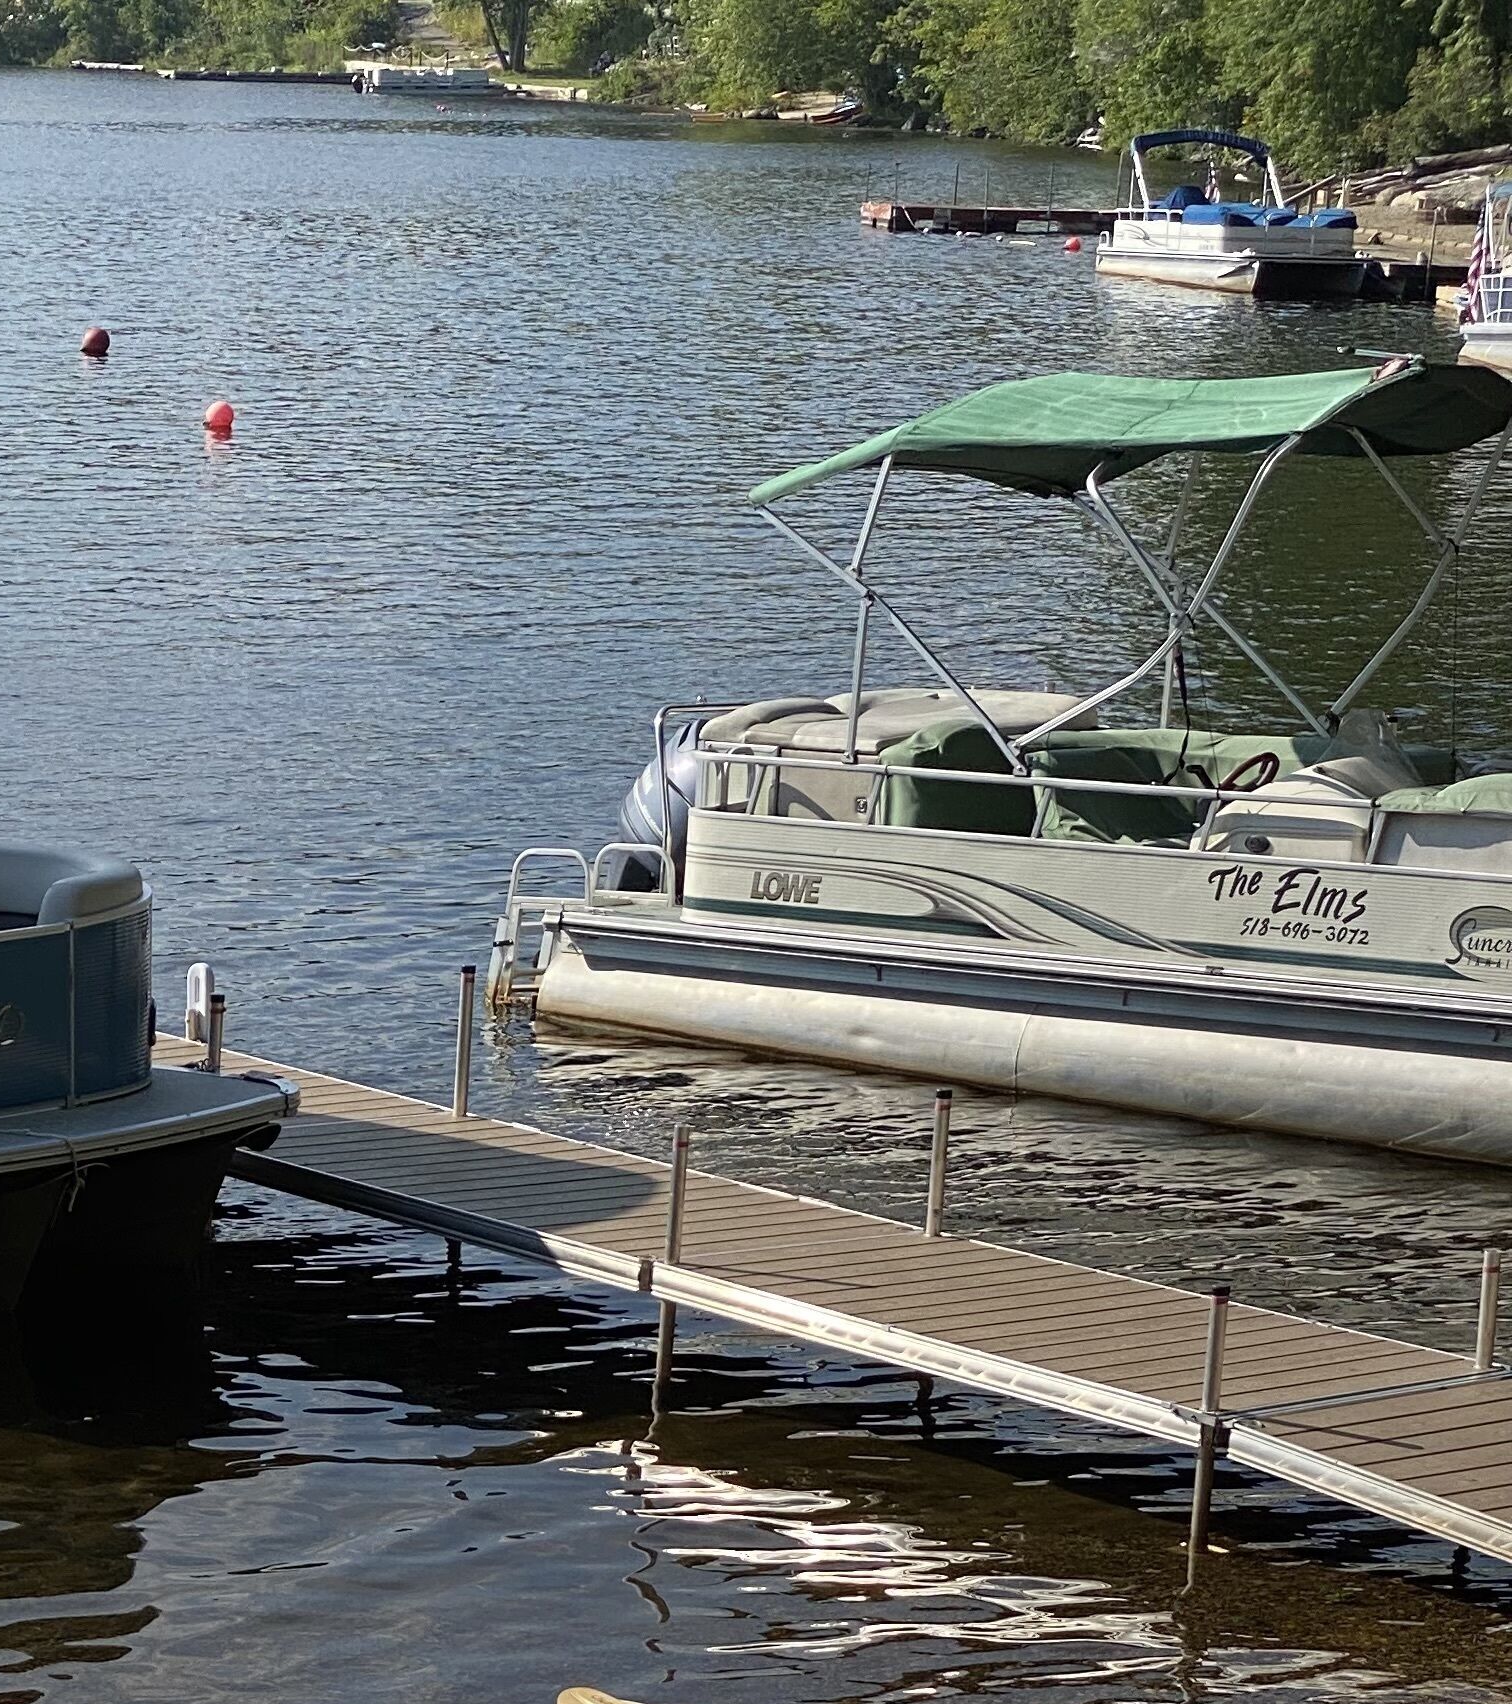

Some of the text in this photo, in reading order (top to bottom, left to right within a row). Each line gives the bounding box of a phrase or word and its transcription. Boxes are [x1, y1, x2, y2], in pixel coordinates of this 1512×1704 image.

[750, 871, 823, 905] LOWE
[1207, 864, 1369, 925] The Elms
[1240, 917, 1370, 946] 518-696-3072
